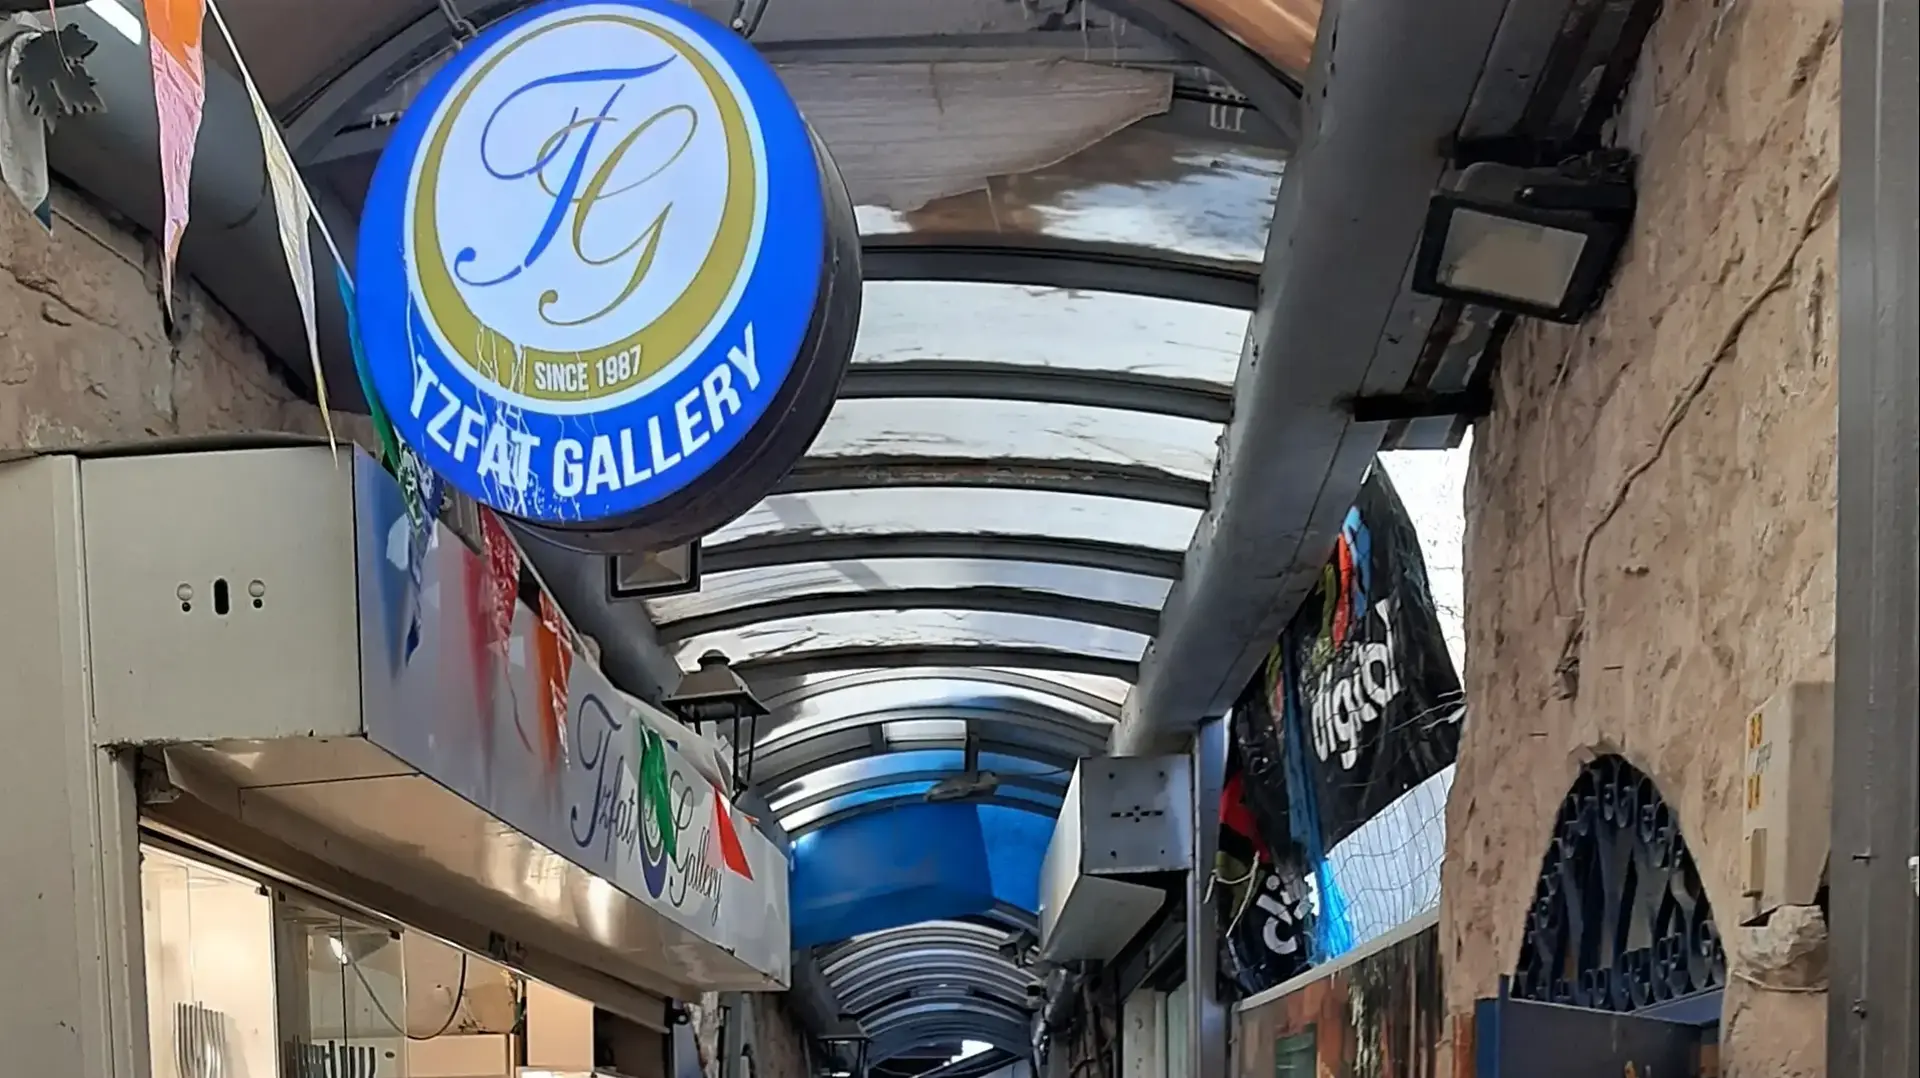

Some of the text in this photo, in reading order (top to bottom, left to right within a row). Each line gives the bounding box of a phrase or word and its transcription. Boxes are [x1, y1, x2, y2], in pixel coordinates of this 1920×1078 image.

[410, 321, 762, 497] TZFAT GALLERY
[534, 344, 642, 392] SINCE 1987
[570, 693, 723, 927] Tzfat Gallery
